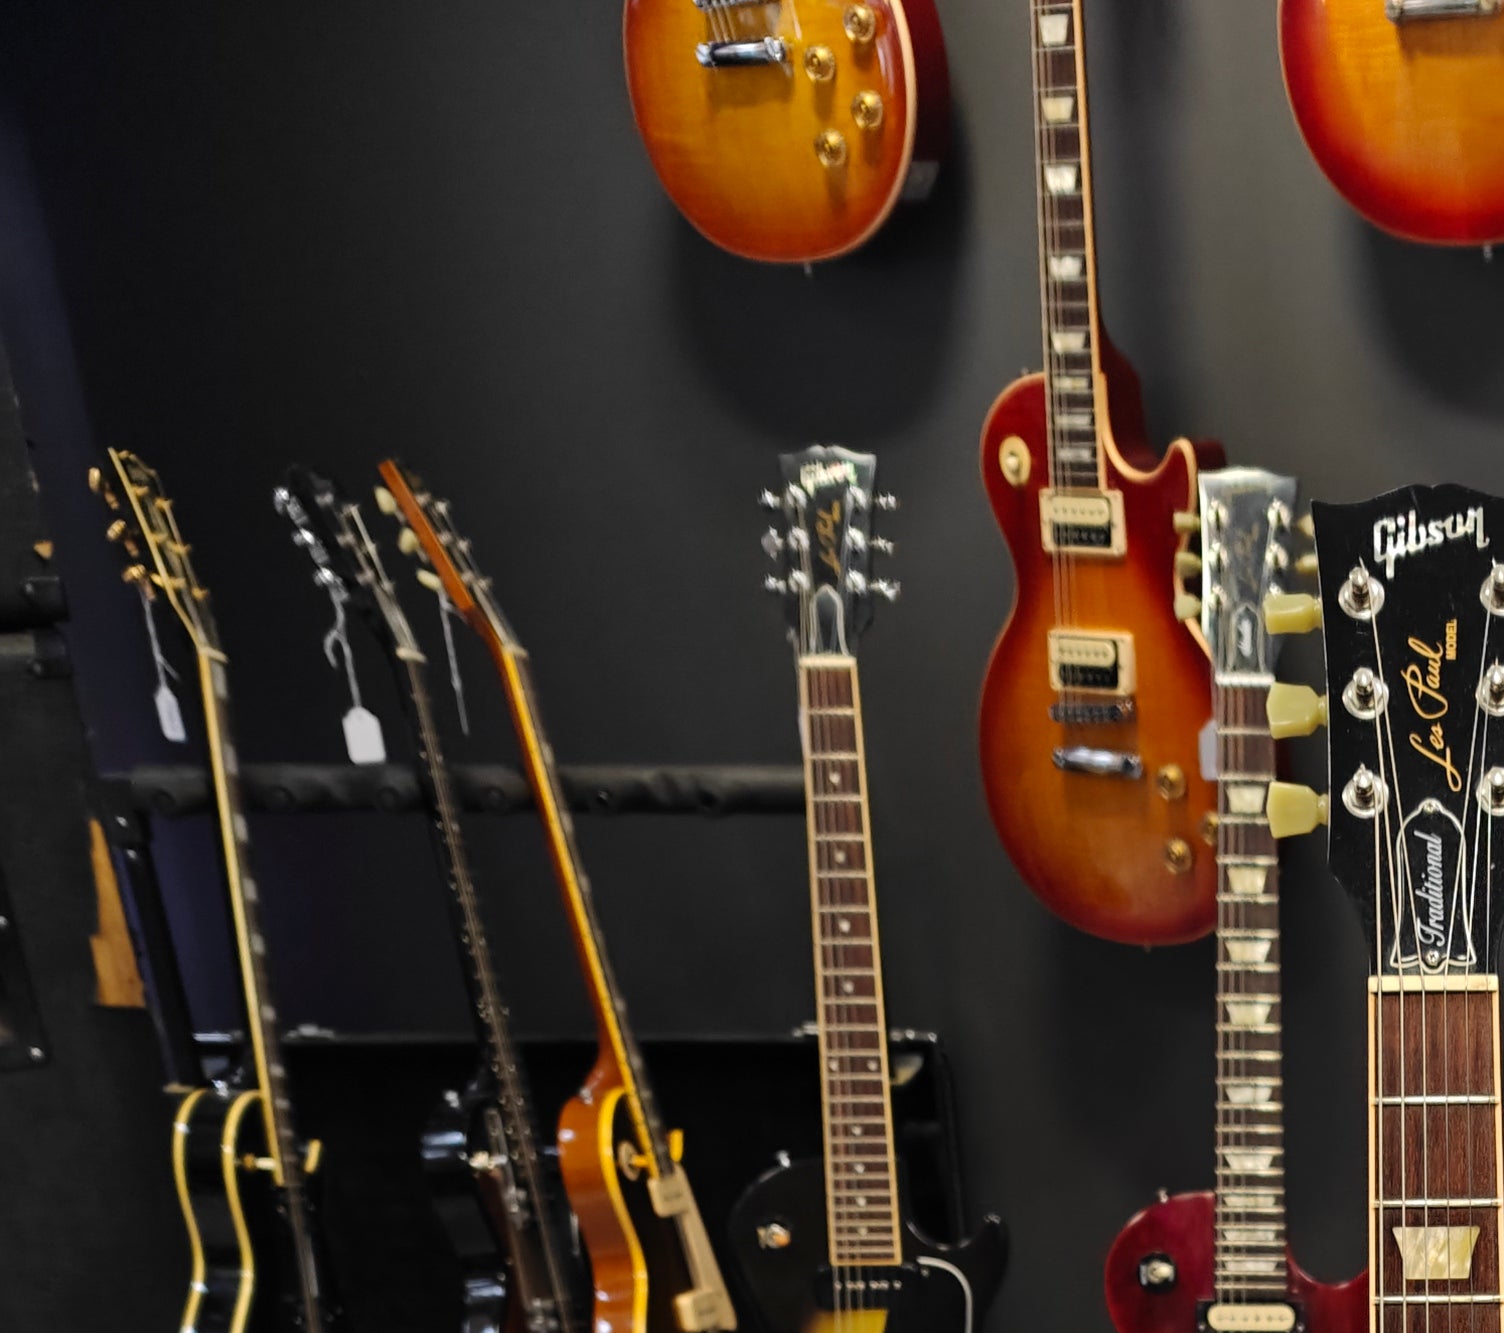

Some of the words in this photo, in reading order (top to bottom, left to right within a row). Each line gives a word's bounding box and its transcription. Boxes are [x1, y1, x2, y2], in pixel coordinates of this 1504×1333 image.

[1373, 506, 1490, 581] Gibson
[1445, 618, 1458, 661] MODEL
[1400, 636, 1449, 720] Paul
[1408, 721, 1462, 792] Les
[1413, 830, 1446, 947] Traditional
